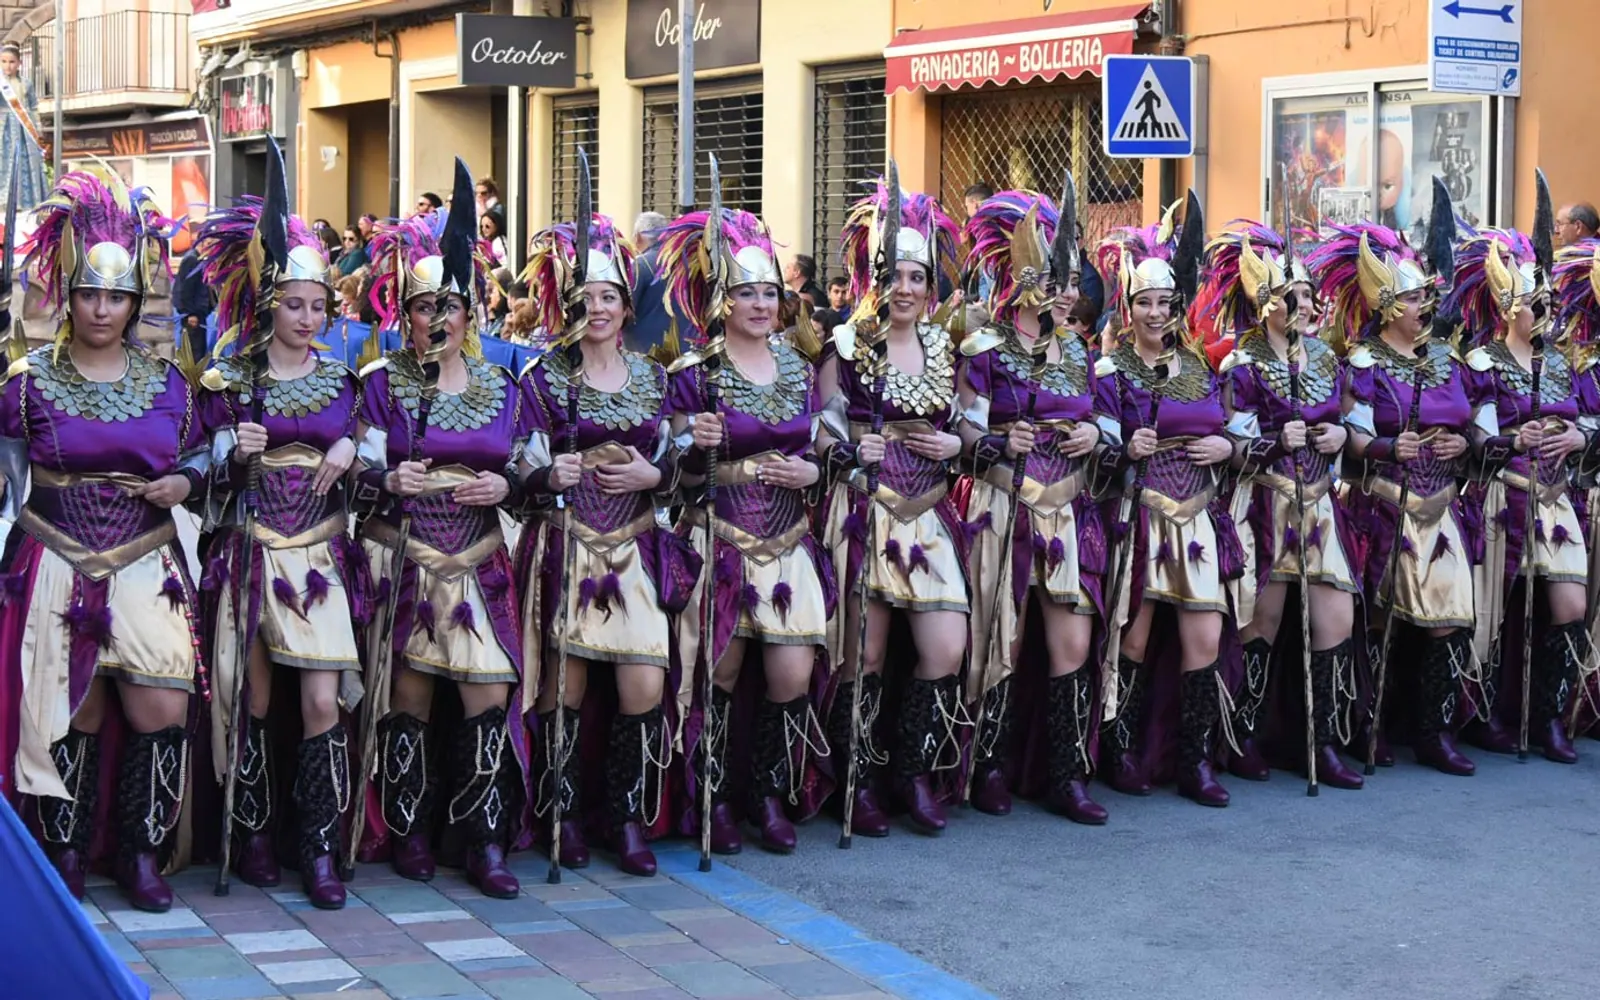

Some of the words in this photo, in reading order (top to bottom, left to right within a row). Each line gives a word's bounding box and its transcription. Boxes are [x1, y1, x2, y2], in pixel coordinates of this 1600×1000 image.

[655, 2, 722, 47] Ocber
[471, 37, 567, 65] October
[911, 49, 1000, 83] PANADERIA
[1019, 37, 1103, 73] BOLLERIA
